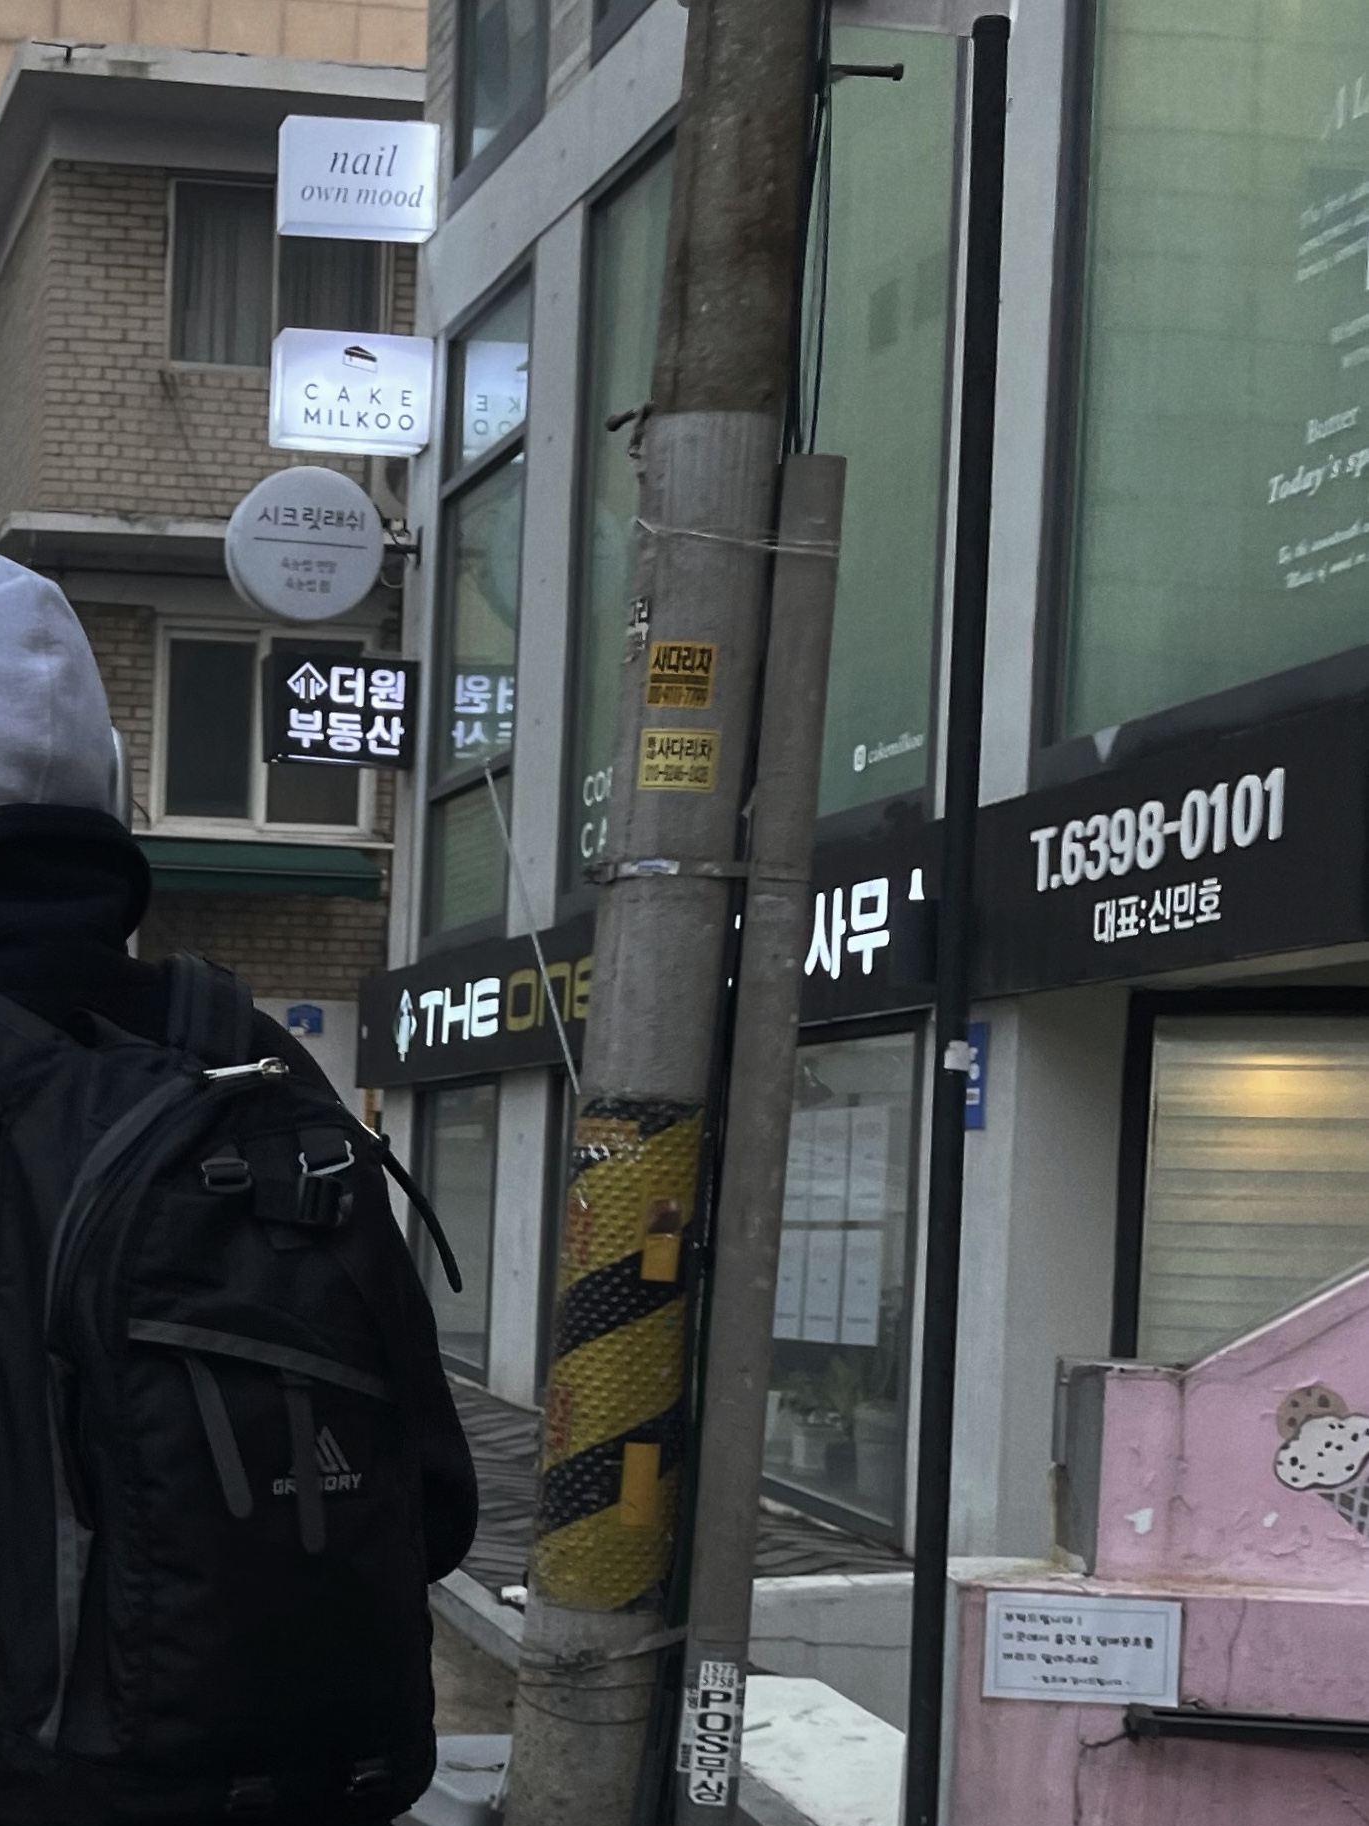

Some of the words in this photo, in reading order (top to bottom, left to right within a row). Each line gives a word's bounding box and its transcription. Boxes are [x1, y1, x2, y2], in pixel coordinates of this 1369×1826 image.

[329, 145, 399, 177] nail
[300, 183, 349, 203] own
[356, 184, 425, 208] mood
[303, 383, 413, 407] CAKE
[303, 407, 415, 431] MILKOO
[257, 504, 366, 532] 시크릿래쉬
[329, 666, 406, 711] 더원
[287, 708, 405, 757] 부동산
[1030, 767, 1287, 893] T.6398-0101
[804, 868, 925, 980] 사무
[419, 977, 501, 1047] THE
[273, 1473, 362, 1496] GRORY
